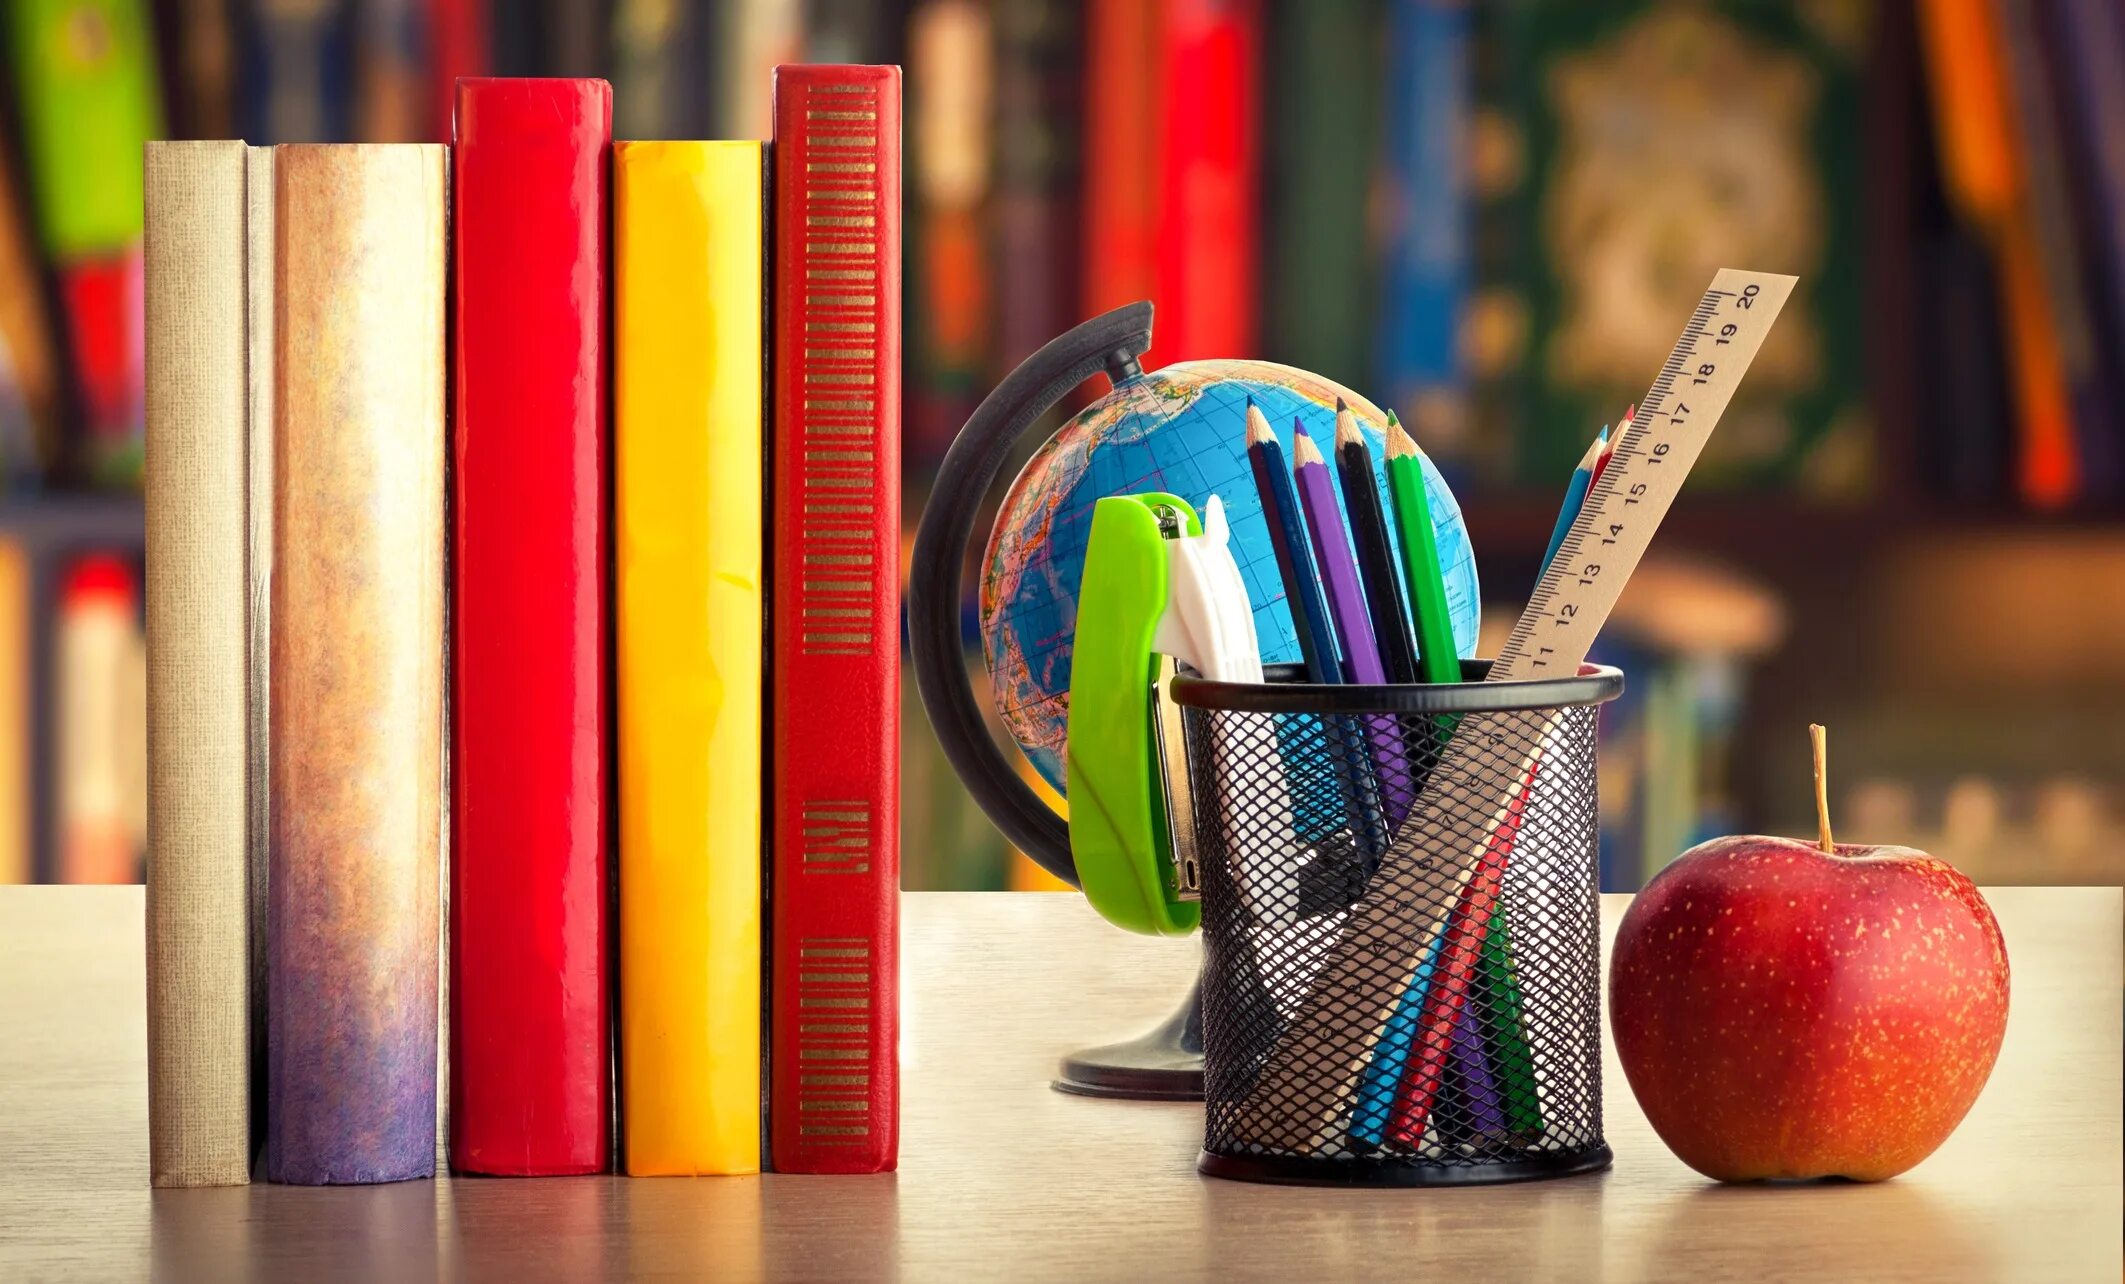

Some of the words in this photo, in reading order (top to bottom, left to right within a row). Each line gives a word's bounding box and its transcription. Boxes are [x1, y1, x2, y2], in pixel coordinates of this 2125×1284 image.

[1736, 284, 1760, 310] 20
[1715, 323, 1738, 346] 19
[1693, 363, 1716, 386] 18
[1670, 402, 1691, 426] 17
[1647, 443, 1670, 466] 16
[1624, 483, 1647, 506] 15
[1601, 523, 1624, 546] 14
[1578, 563, 1601, 586] 13
[1555, 604, 1579, 627] 12
[1532, 647, 1554, 669] 11
